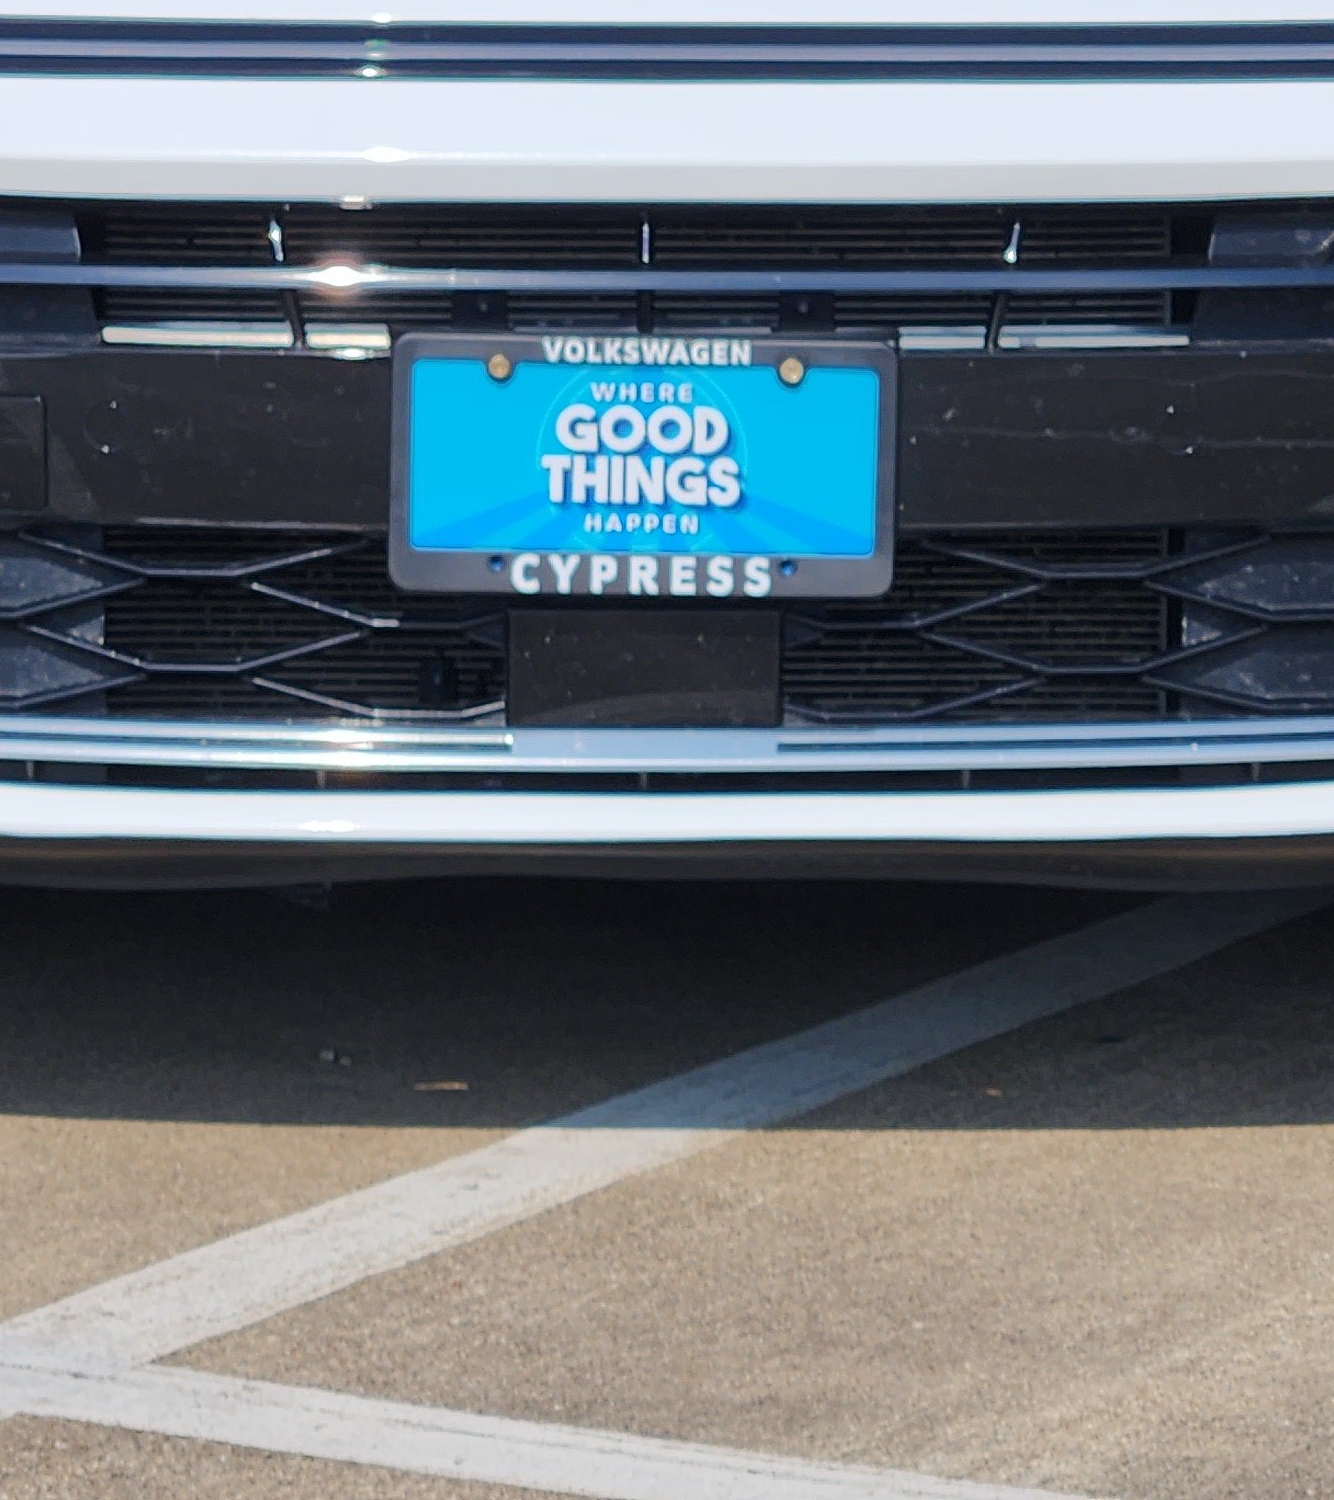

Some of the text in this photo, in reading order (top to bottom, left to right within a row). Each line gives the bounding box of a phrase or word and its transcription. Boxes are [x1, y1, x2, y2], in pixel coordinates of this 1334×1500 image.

[542, 337, 752, 366] VOLKSWAGEN
[590, 382, 694, 404] WHERE
[556, 403, 729, 455] GOOD
[542, 454, 741, 507] THINGS
[584, 512, 700, 535] HAPPEN
[511, 553, 773, 597] CYPRESS
